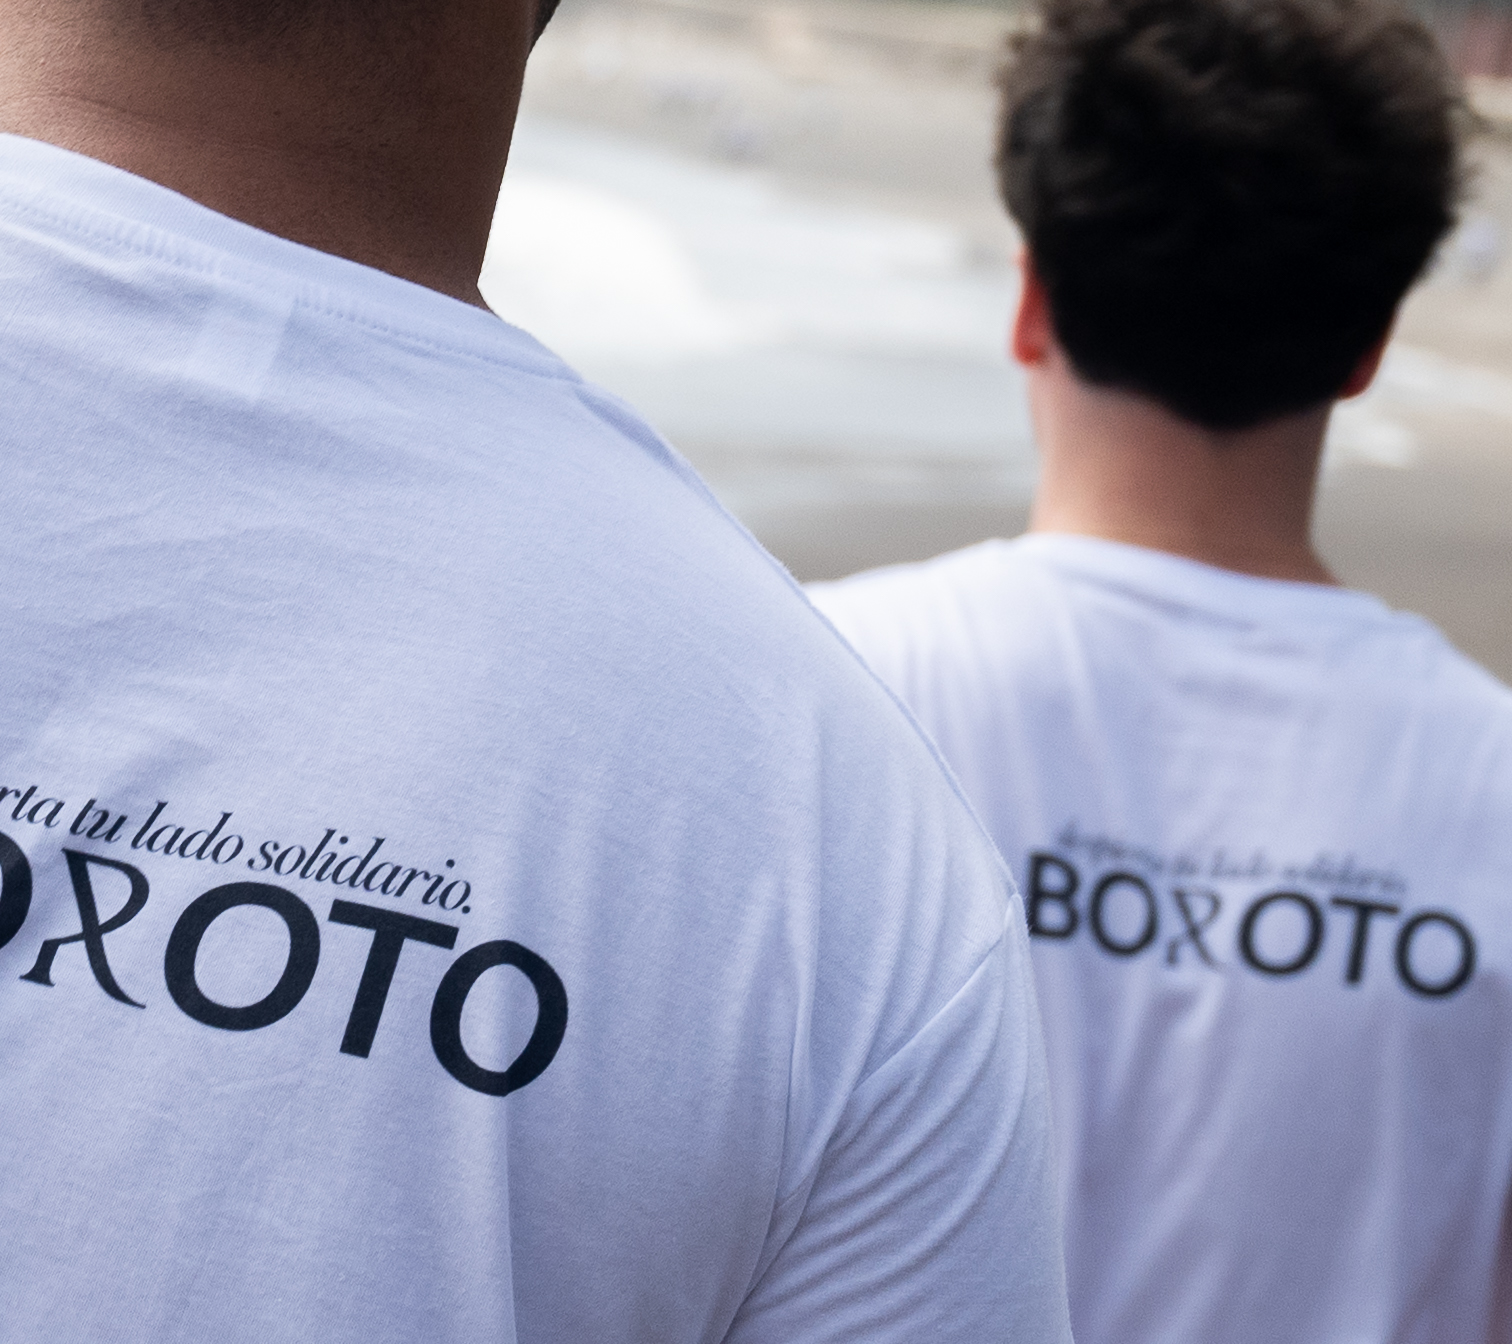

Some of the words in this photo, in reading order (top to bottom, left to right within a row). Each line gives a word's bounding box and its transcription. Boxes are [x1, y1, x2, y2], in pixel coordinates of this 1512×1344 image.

[69, 798, 128, 843] tu
[130, 800, 244, 864] lado
[247, 828, 472, 914] solidario.
[1024, 850, 1479, 1004] BOROTO
